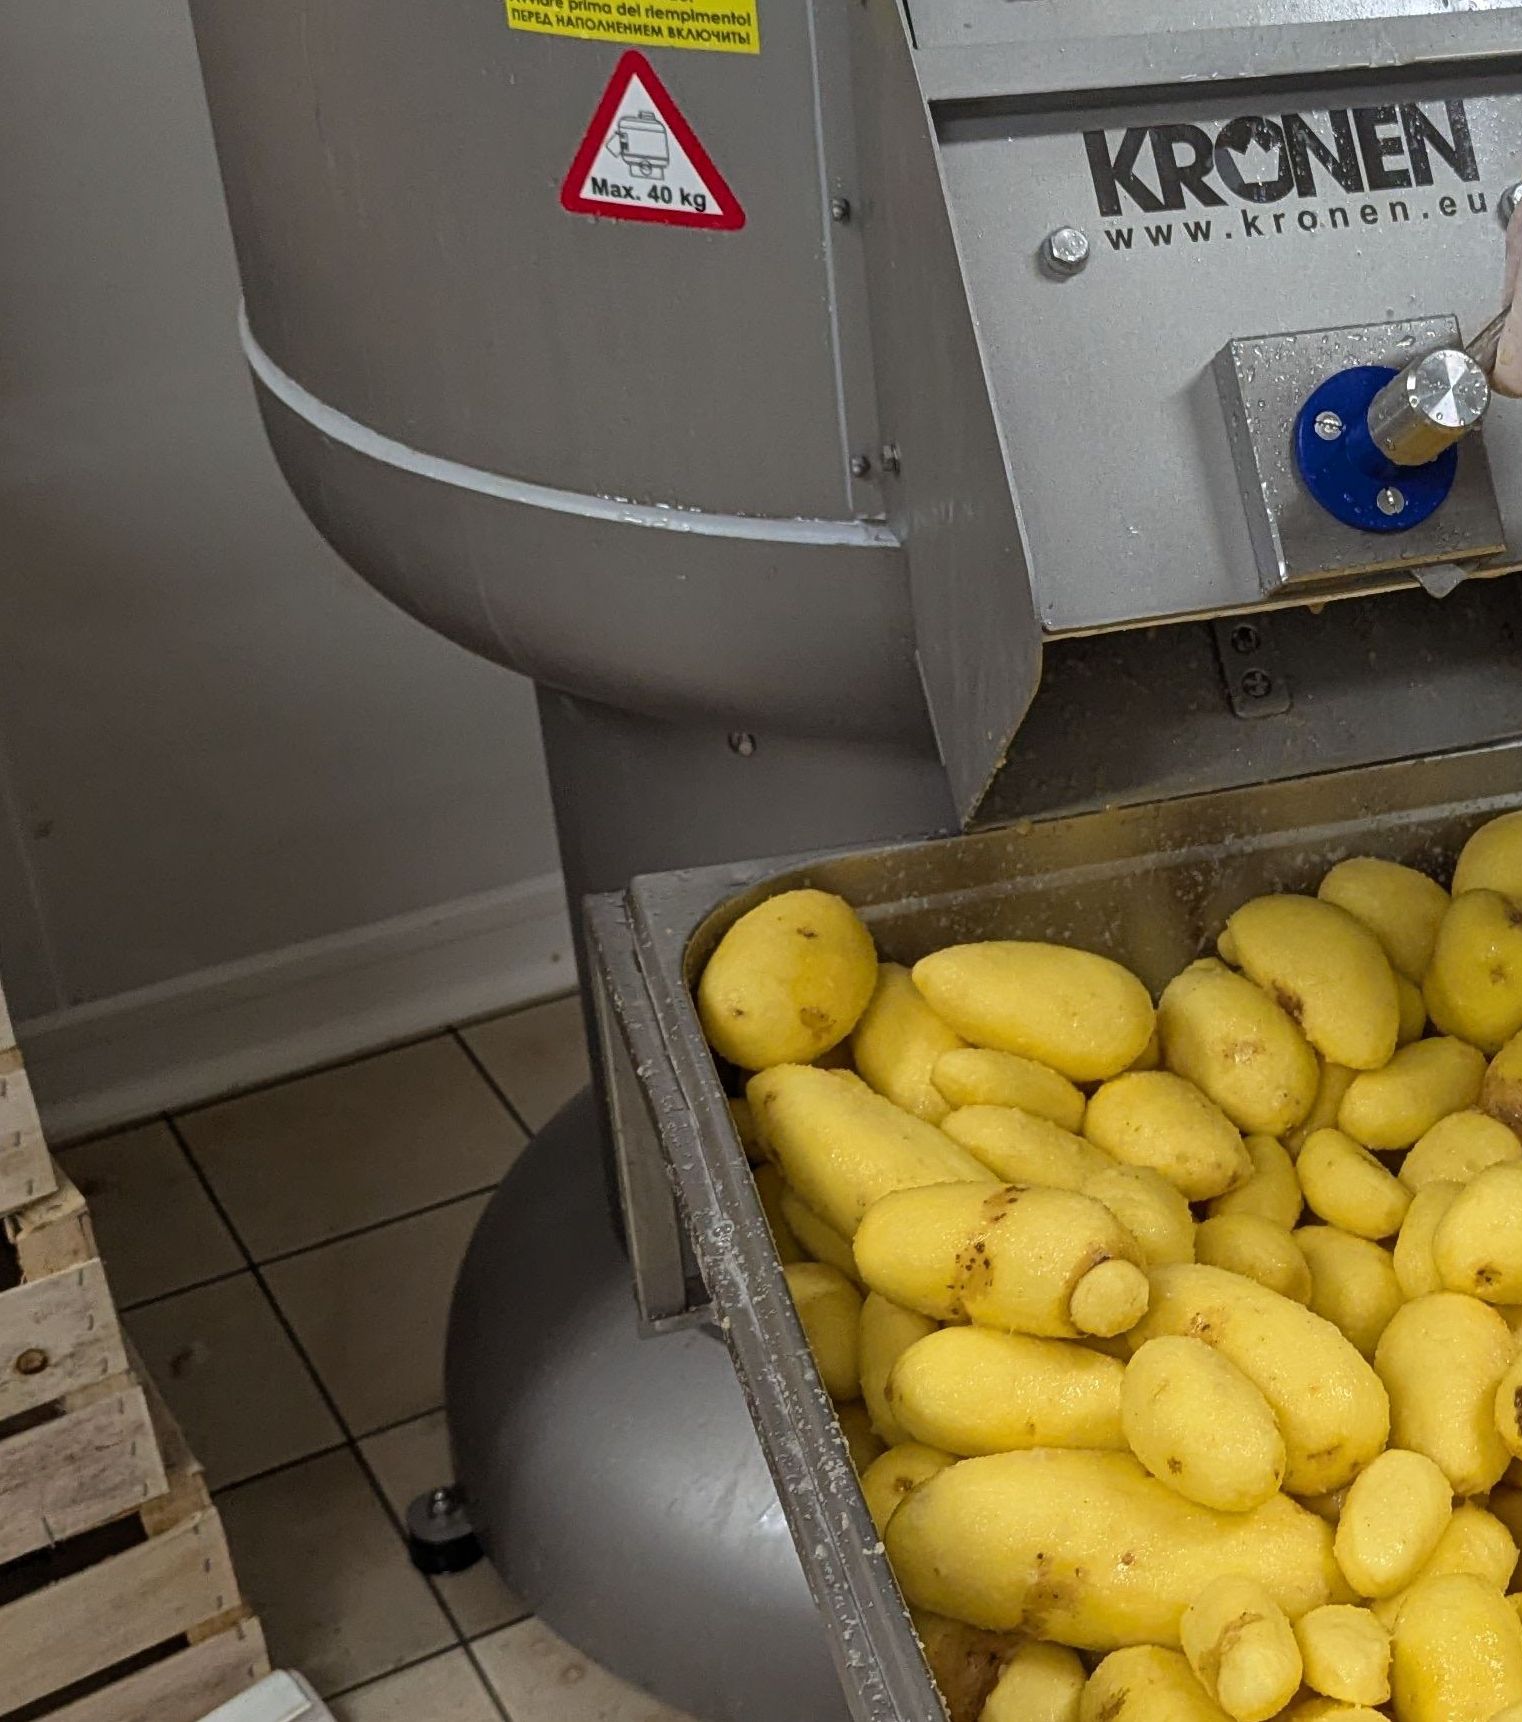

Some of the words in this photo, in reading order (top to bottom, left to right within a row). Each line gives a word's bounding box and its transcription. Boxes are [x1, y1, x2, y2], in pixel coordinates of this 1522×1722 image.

[511, 8, 553, 27] ПЕРЕД
[555, 15, 664, 39] НАПОЛНЕНИЕМ
[667, 26, 751, 45] ВКЛЮЧИТЬ!
[569, 0, 612, 14] prima
[616, 3, 641, 18] del
[645, 5, 751, 27] riempimento!
[1083, 100, 1479, 217] KRONEN
[591, 177, 640, 202] Max.
[647, 186, 673, 205] 40
[681, 188, 706, 213] kg
[1104, 191, 1488, 251] www.kronen.eu
